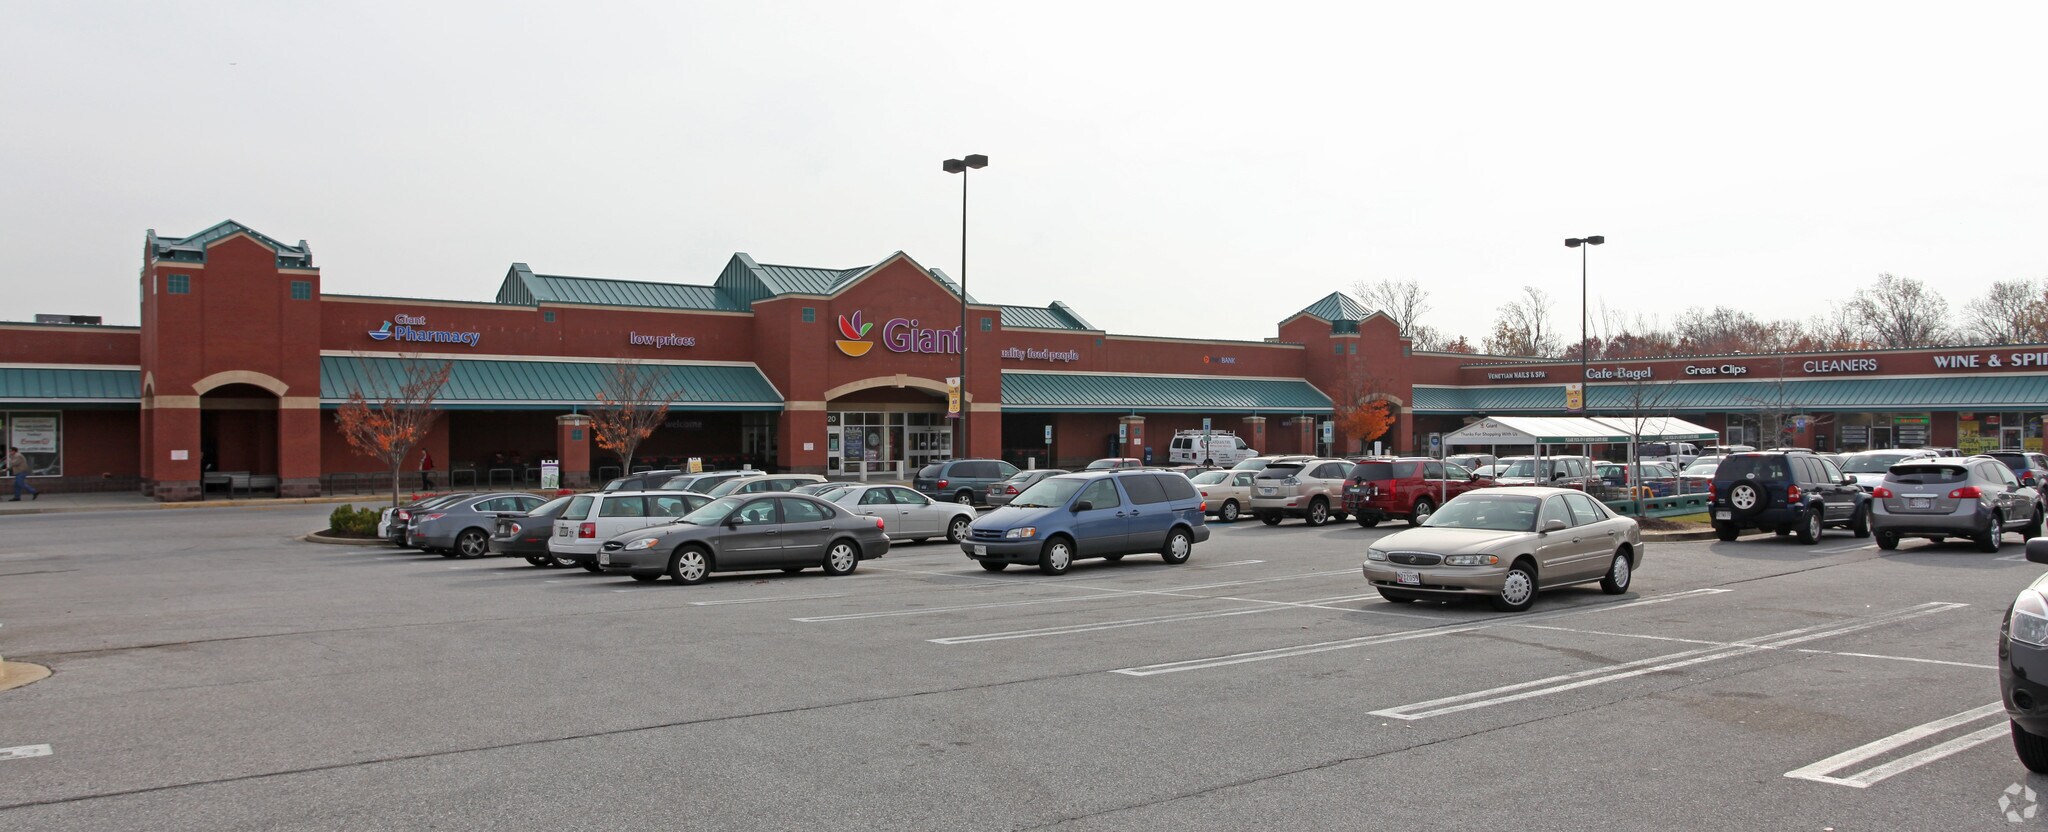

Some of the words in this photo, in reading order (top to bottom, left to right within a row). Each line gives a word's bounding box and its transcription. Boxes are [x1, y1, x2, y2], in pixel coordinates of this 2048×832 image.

[394, 313, 426, 325] Giant
[395, 326, 480, 347] Pharmacy
[630, 331, 654, 345] low
[656, 333, 696, 349] prices
[883, 317, 968, 354] Giant
[1027, 347, 1049, 359] food
[1049, 349, 1079, 362] people
[1933, 354, 1980, 368] WINE
[1987, 353, 2002, 367] &
[1616, 366, 1652, 380] Bagel
[1685, 365, 1717, 375] Great
[1720, 364, 1747, 376] Clips
[1803, 358, 1877, 373] CLEANERS
[1488, 372, 1513, 380] VENETIAN
[1514, 371, 1530, 379] NAILS
